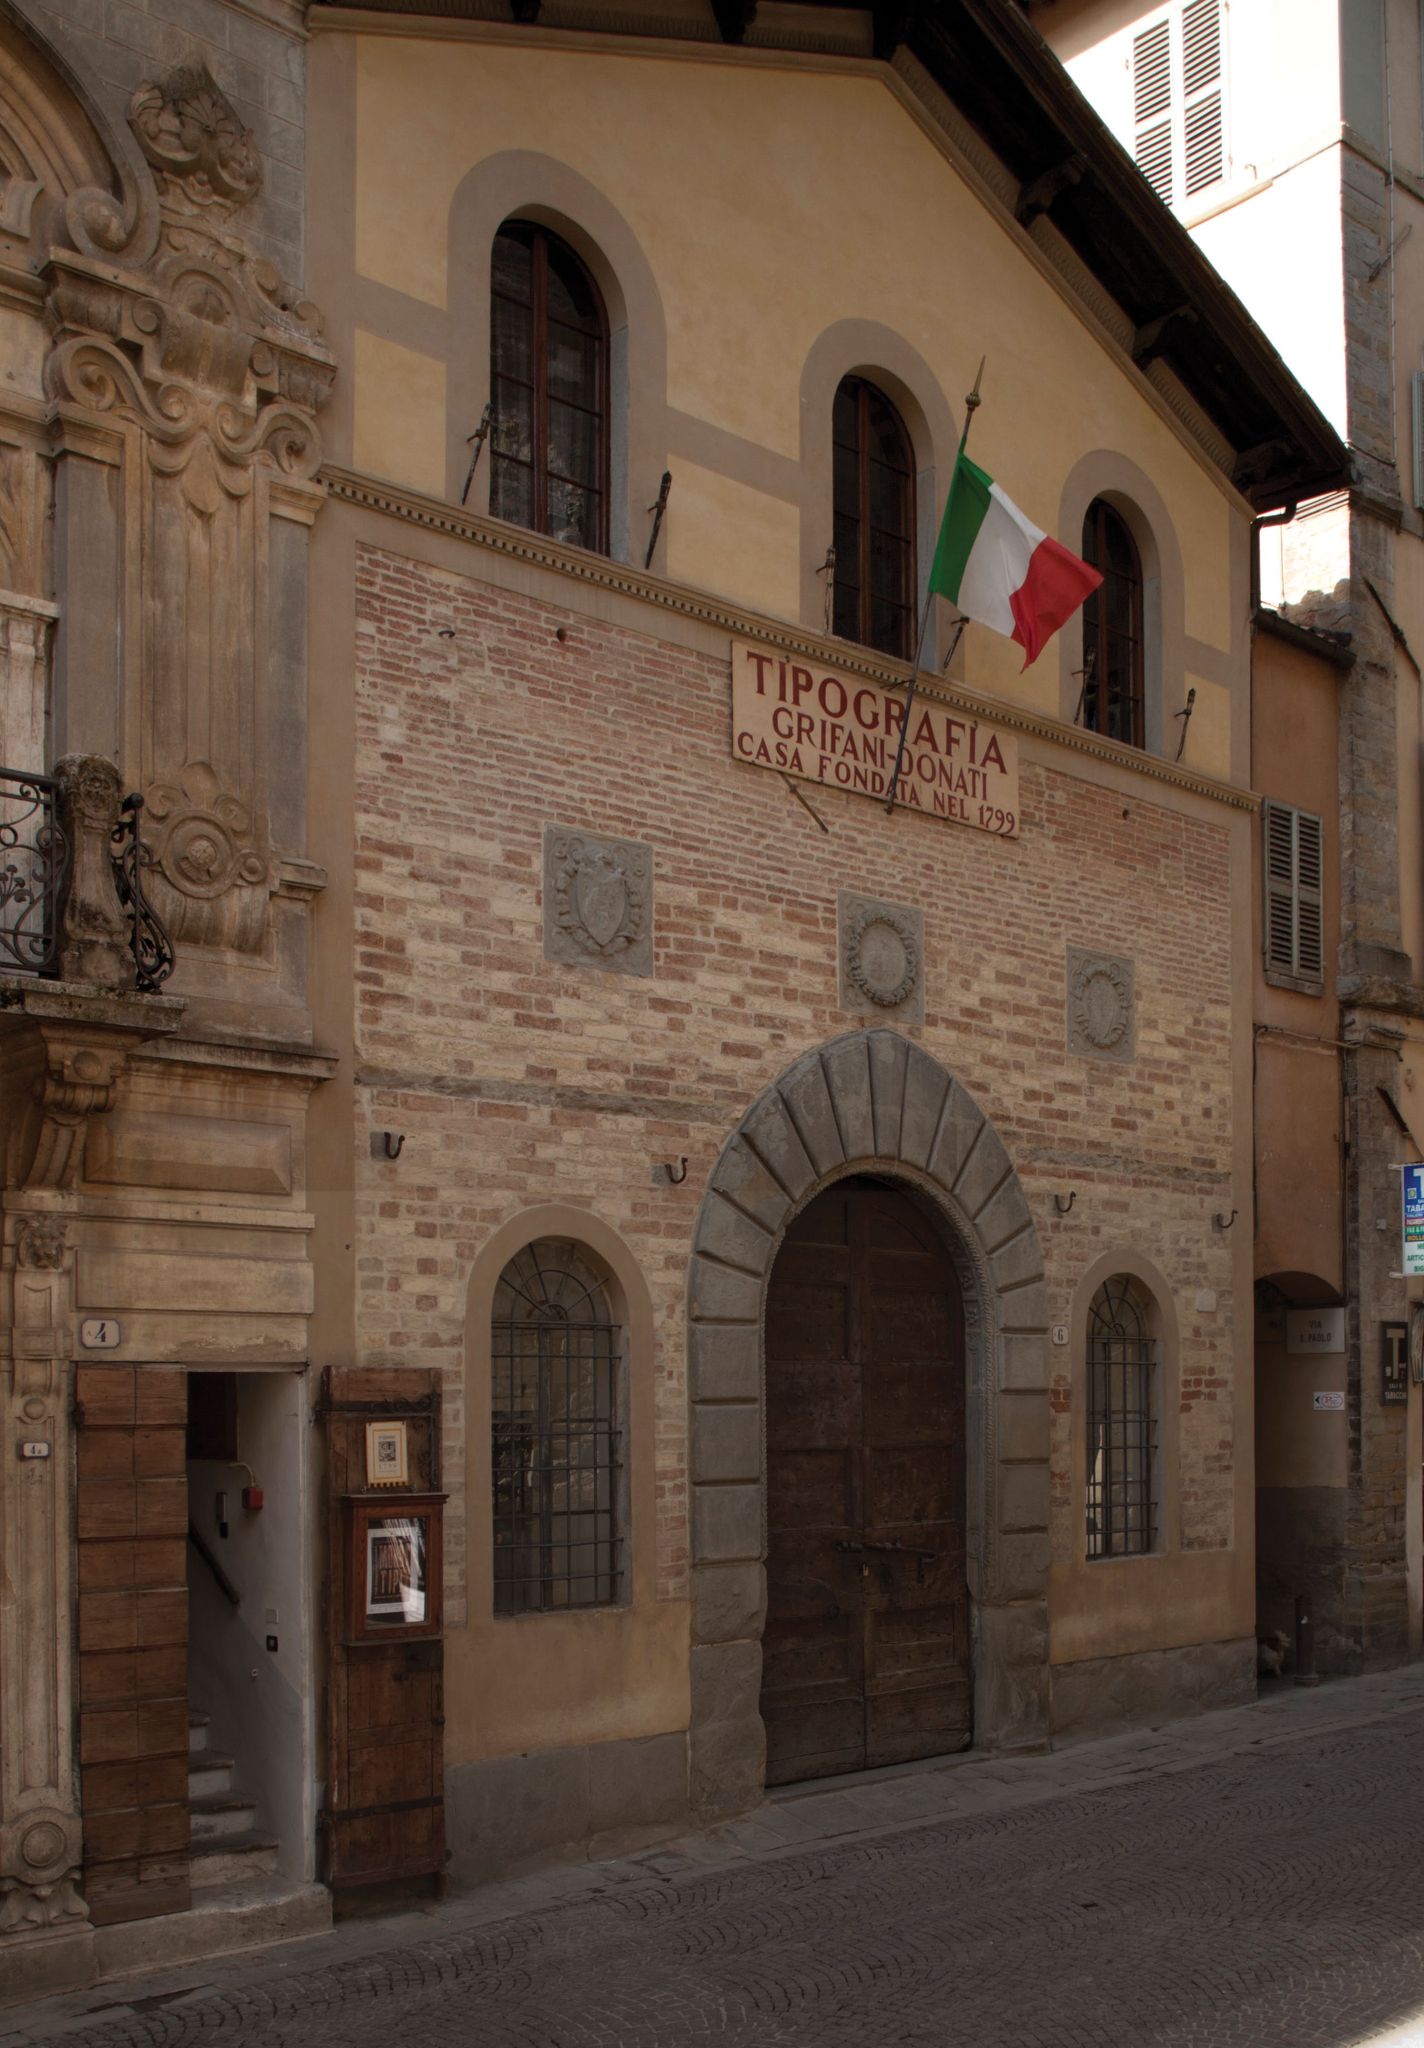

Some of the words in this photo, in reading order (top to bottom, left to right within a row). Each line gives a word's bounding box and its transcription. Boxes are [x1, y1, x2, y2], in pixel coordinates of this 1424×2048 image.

[746, 651, 1008, 774] TIPOGRAFIA
[772, 707, 988, 801] GRIFANI-DONATI
[737, 731, 804, 773] CASA
[818, 755, 921, 806] FONDATA
[933, 792, 970, 822] NEL
[978, 804, 1015, 835] 1799
[95, 1322, 106, 1342] 4
[1057, 1328, 1064, 1341] 6
